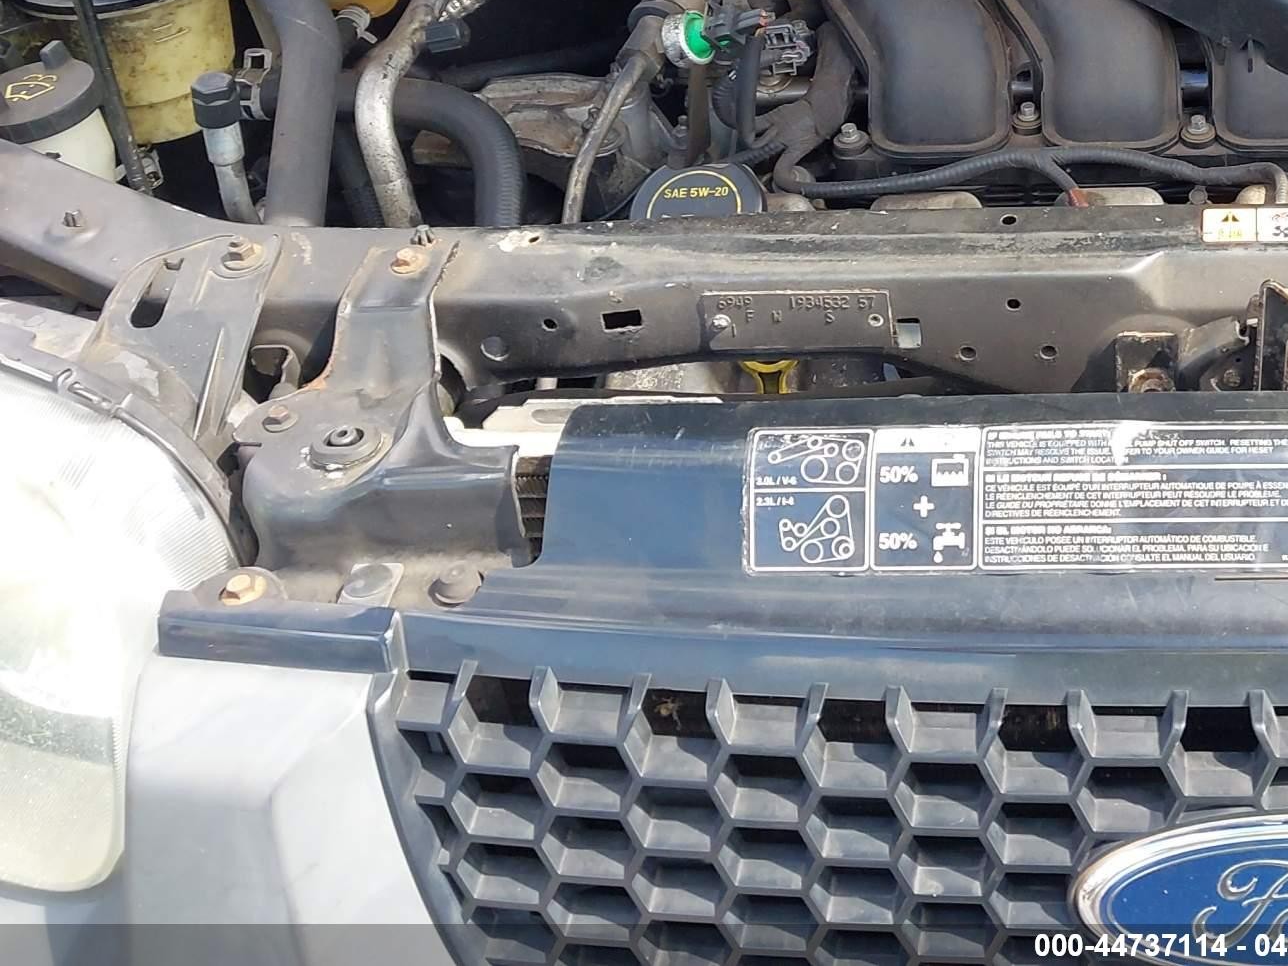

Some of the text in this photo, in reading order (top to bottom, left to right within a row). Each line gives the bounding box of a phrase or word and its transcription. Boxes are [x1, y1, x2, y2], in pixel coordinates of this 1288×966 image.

[664, 186, 729, 199] SAE 5W-20
[879, 465, 918, 484] 50%
[879, 532, 918, 550] 50%
